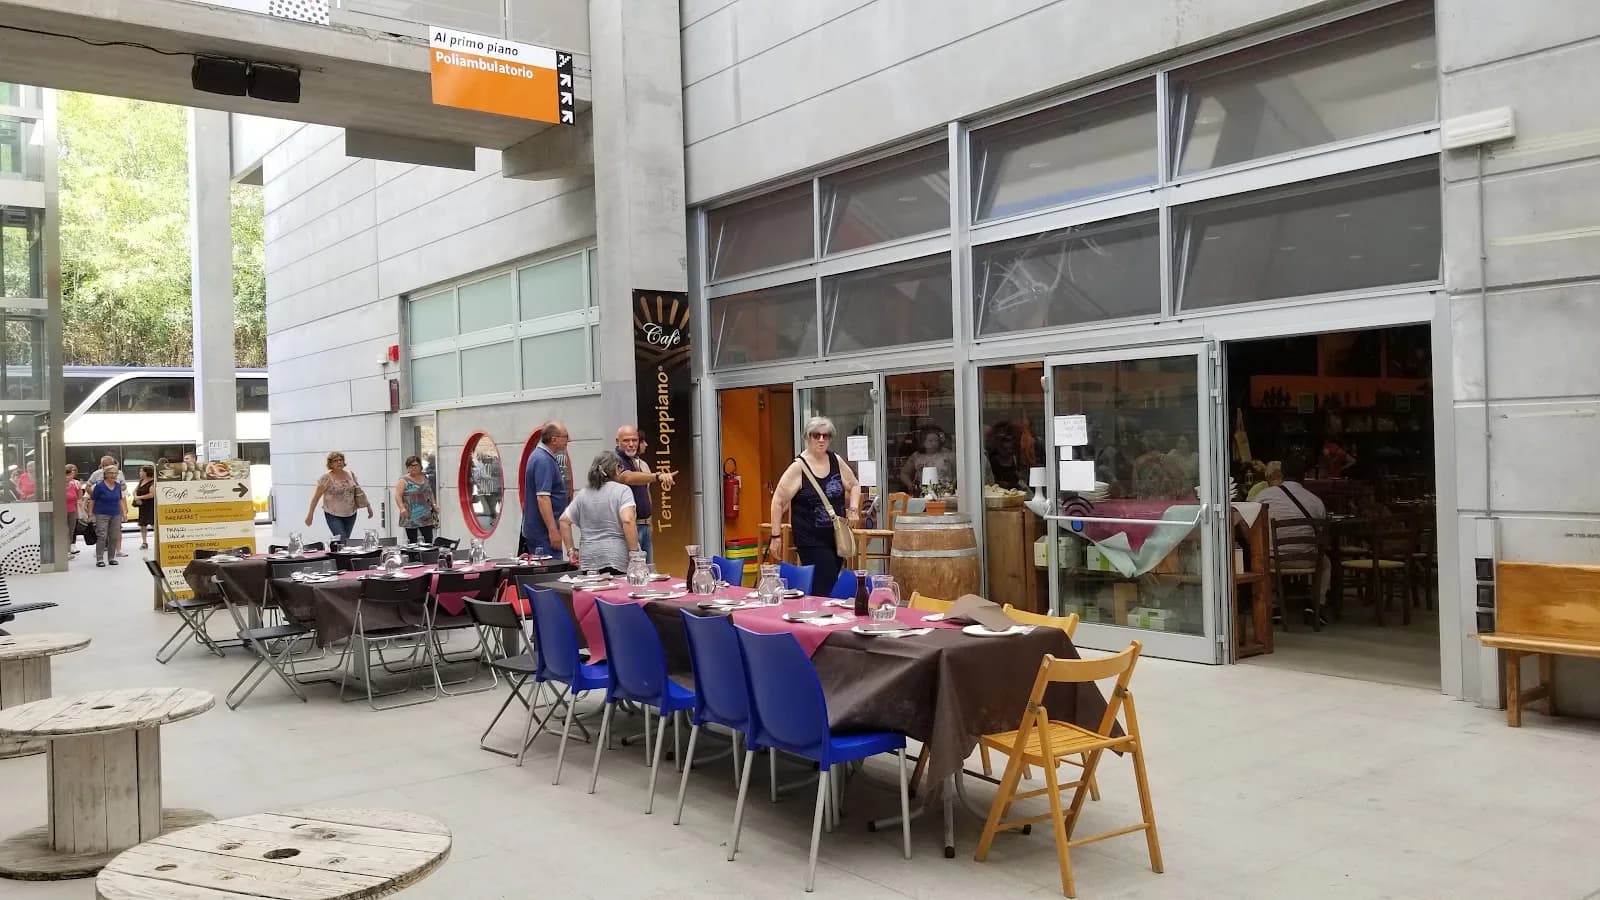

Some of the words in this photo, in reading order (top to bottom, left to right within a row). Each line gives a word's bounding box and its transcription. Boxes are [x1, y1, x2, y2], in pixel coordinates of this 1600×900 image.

[434, 32, 447, 44] Al
[449, 36, 484, 50] primo
[486, 43, 519, 57] piano
[436, 51, 534, 79] Poliambulatorio
[657, 481, 672, 533] Terre
